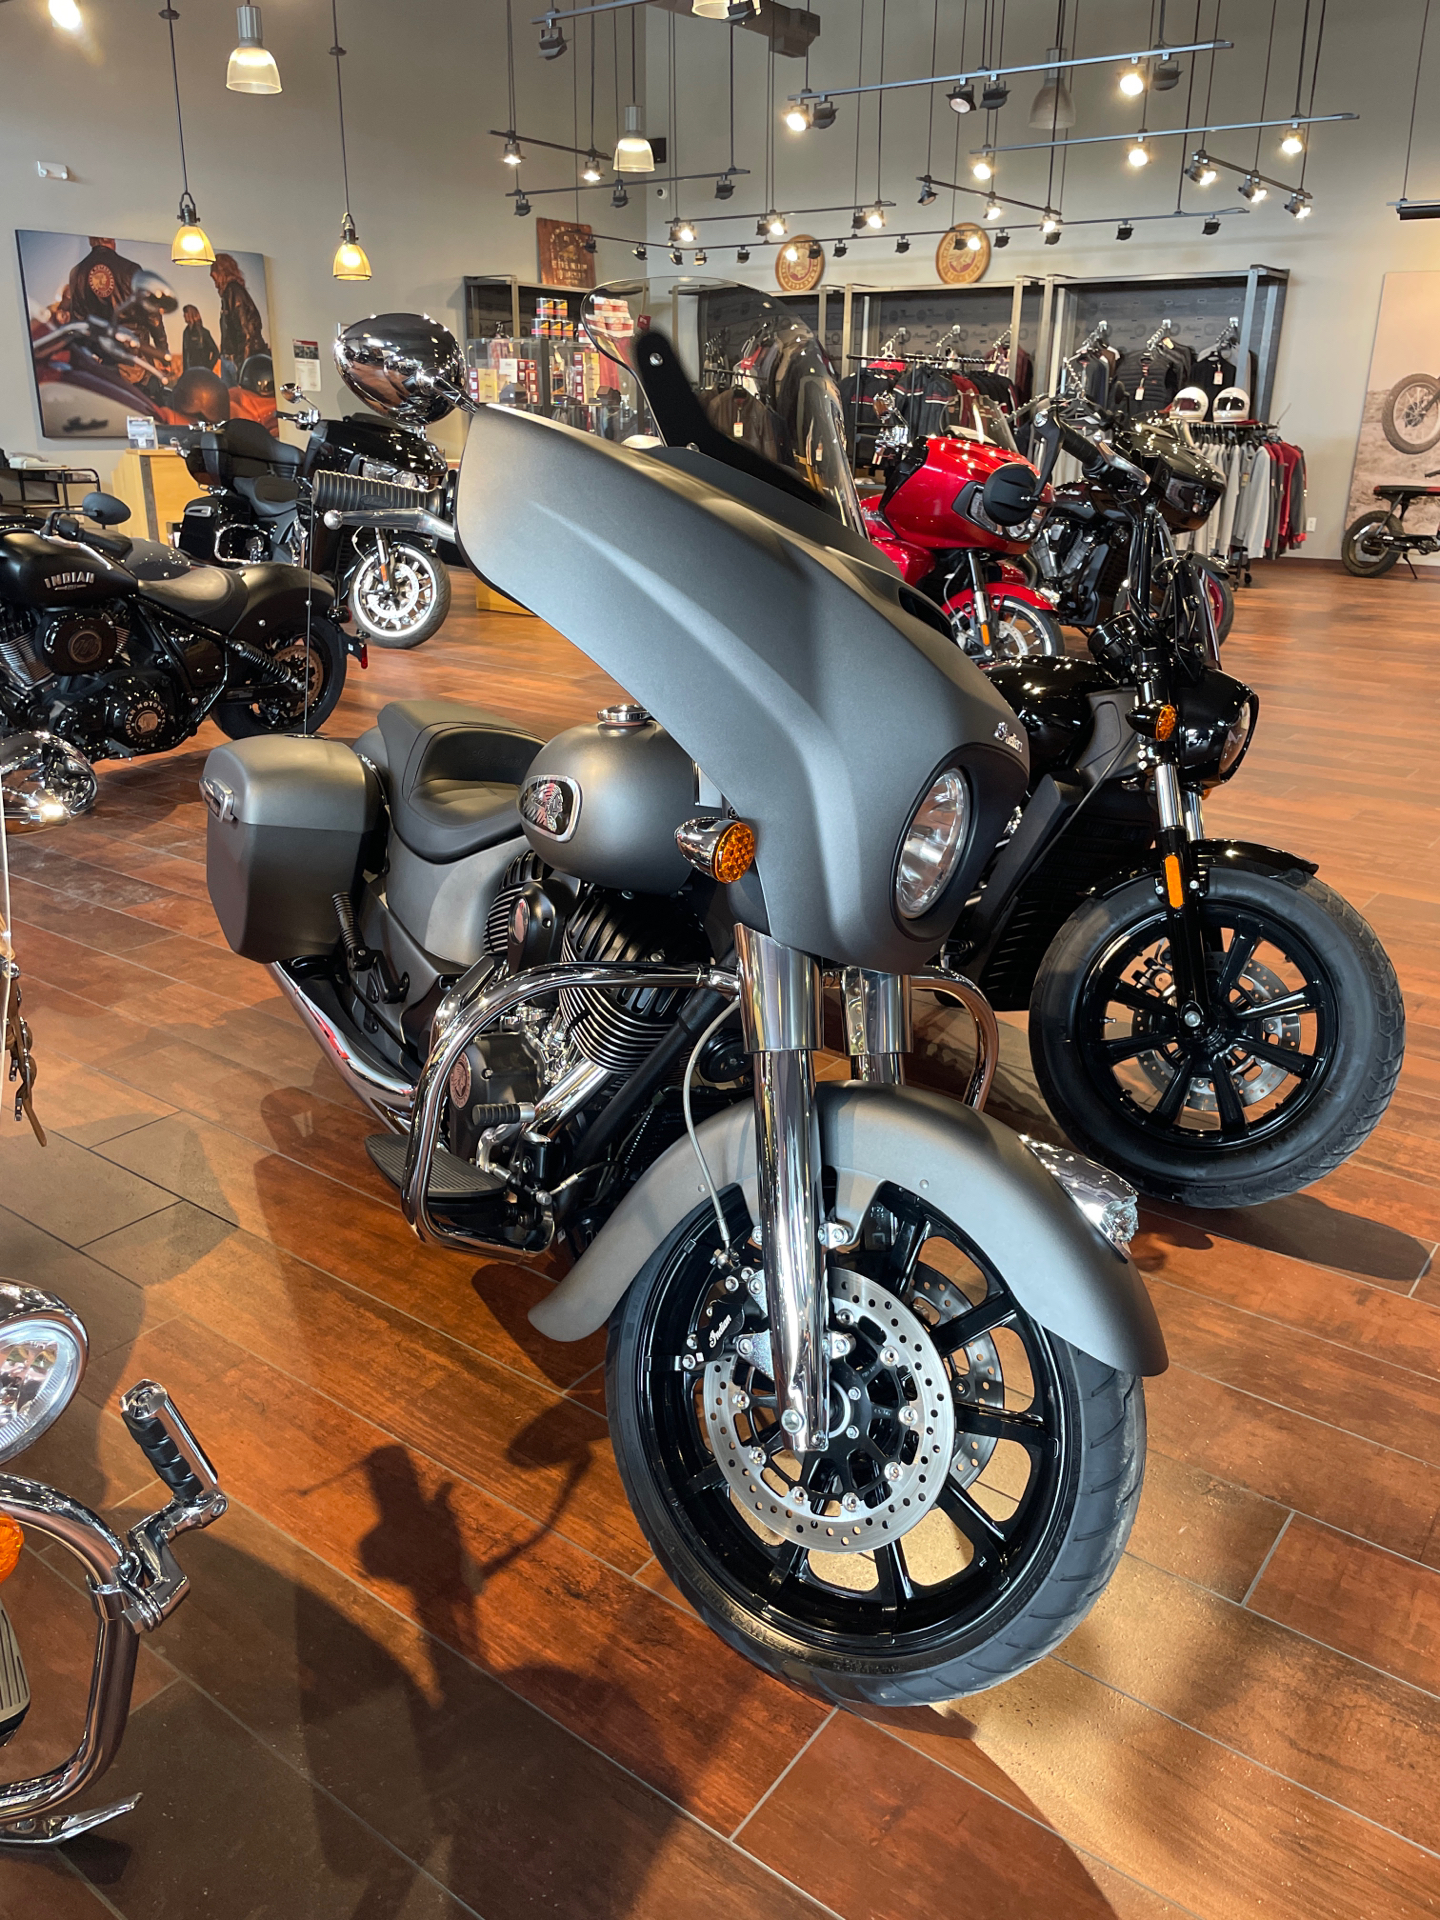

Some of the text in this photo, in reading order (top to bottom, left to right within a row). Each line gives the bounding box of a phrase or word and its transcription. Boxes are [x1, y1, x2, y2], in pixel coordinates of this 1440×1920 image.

[44, 571, 95, 589] INDIAN
[125, 701, 166, 738] INDIAN MOTORCYCLE
[709, 1314, 732, 1348] Indian
